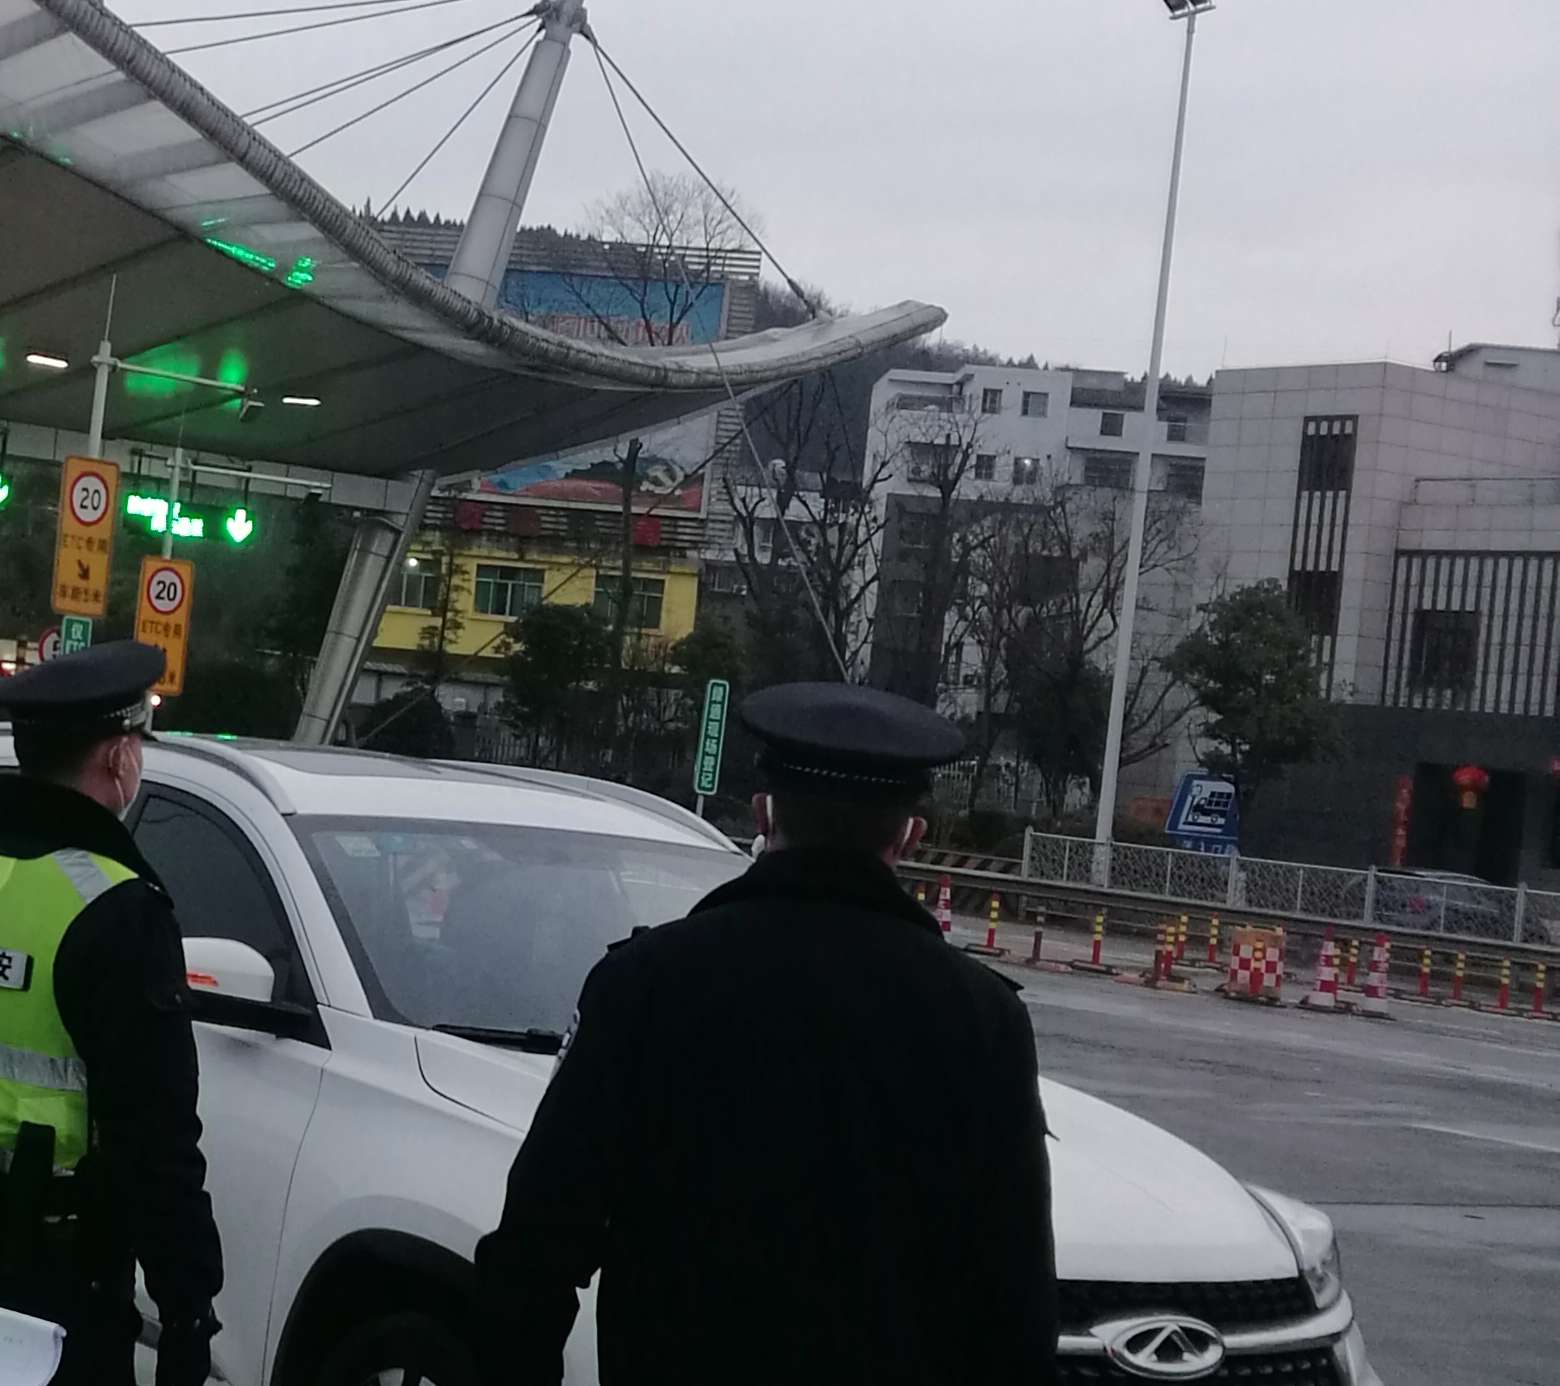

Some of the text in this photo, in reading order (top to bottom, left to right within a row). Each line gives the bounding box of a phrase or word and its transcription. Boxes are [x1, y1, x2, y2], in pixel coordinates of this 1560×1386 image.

[79, 487, 102, 511] 20
[63, 532, 108, 555] ETC专用
[154, 580, 178, 603] 20
[141, 620, 183, 640] ETC专用
